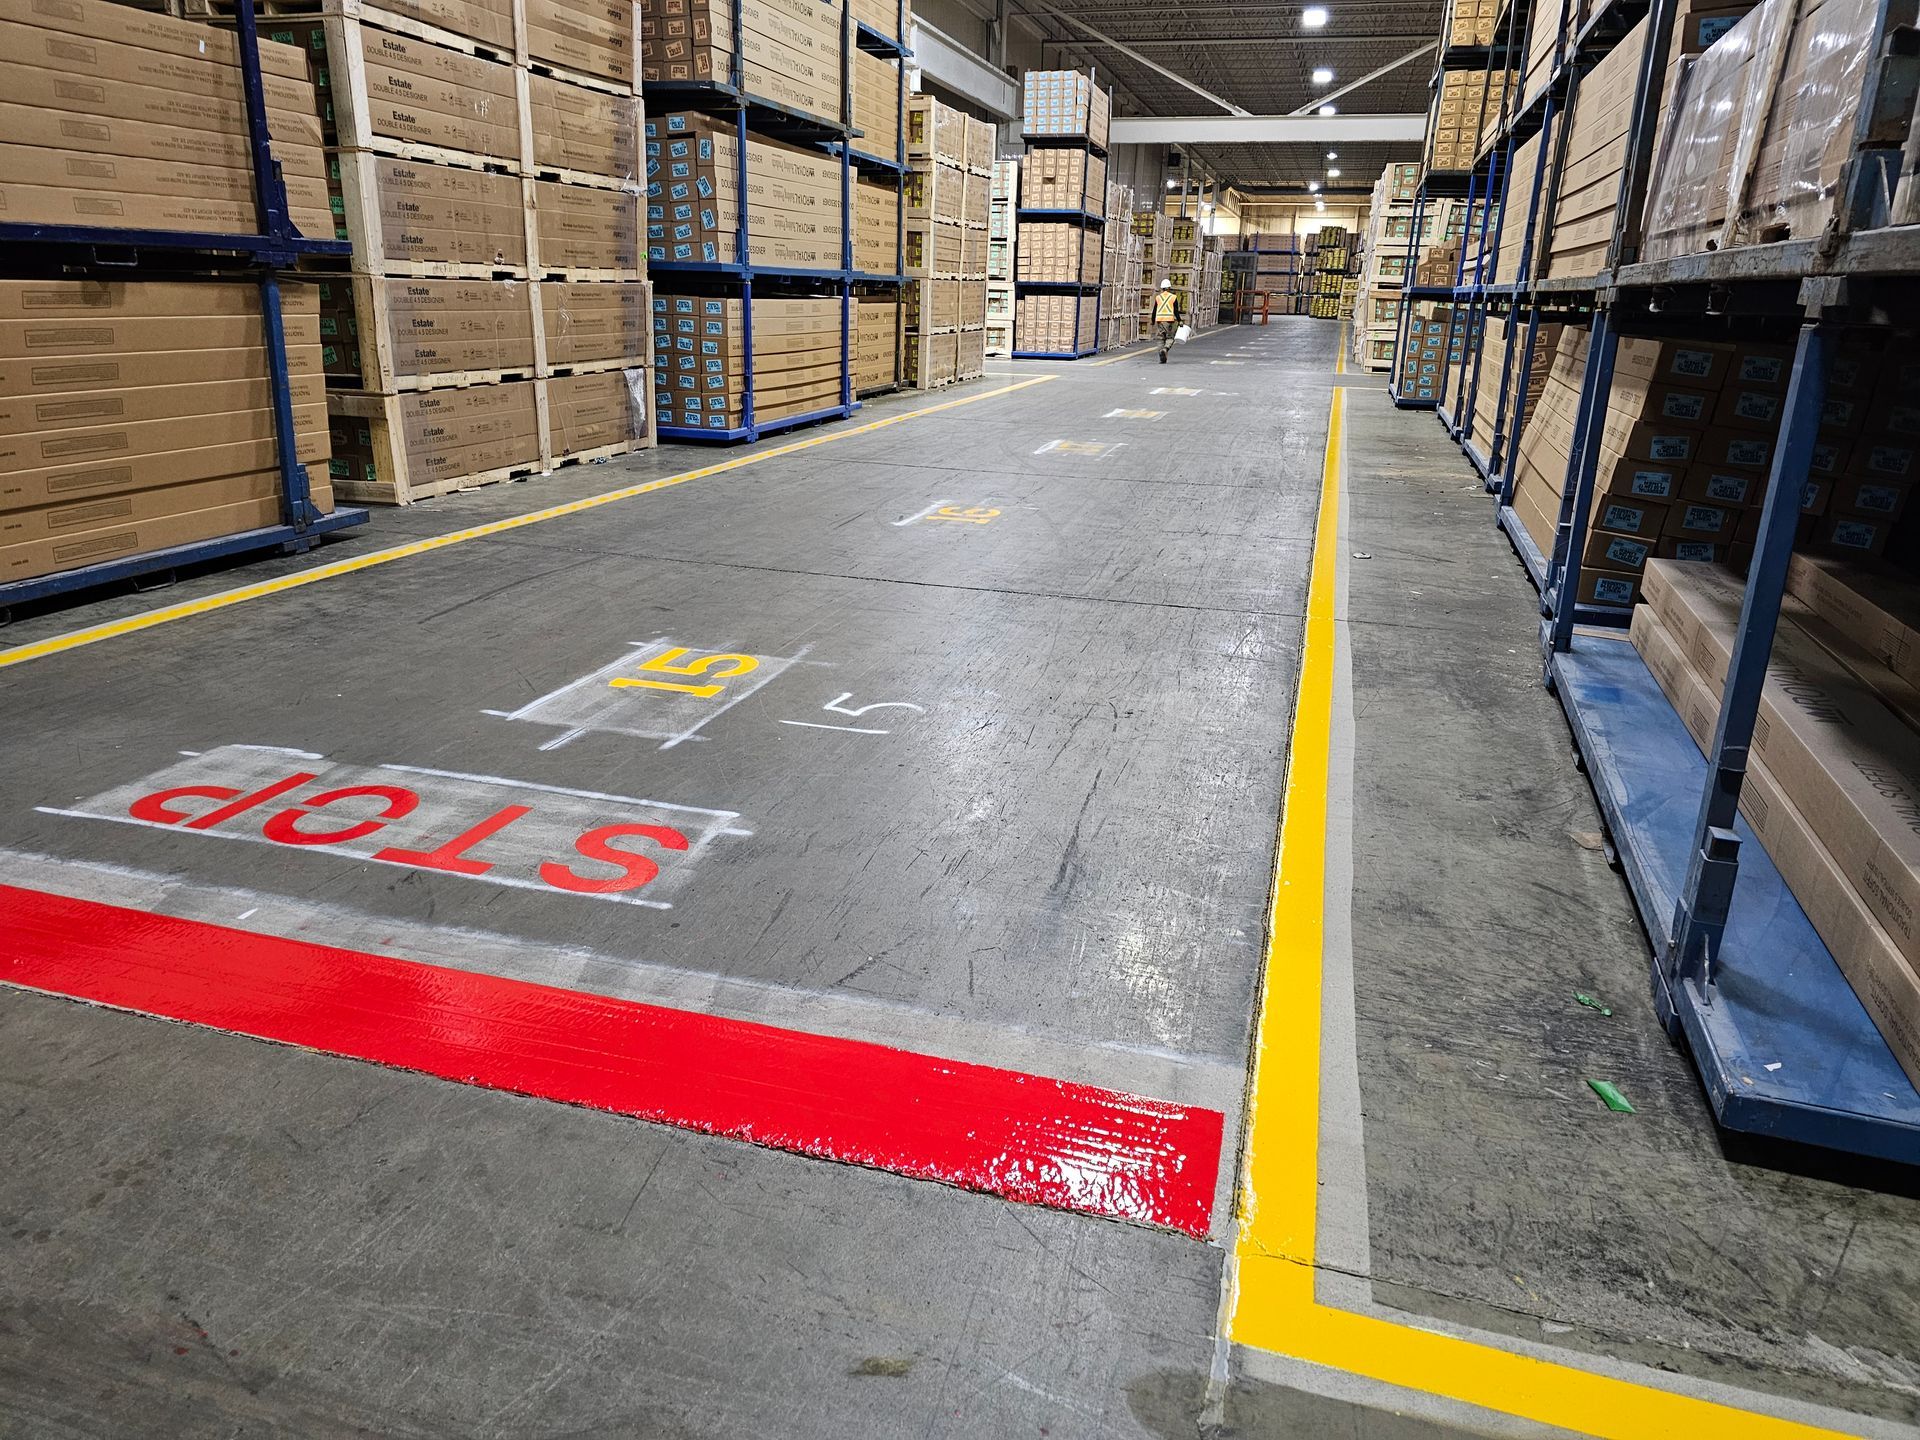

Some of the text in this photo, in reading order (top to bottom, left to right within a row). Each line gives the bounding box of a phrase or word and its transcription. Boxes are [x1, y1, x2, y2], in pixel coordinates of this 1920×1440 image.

[608, 8, 622, 20] Estate
[743, 4, 759, 20] ESIGNER
[792, 30, 808, 46] ROYAL
[382, 38, 406, 53] Estate
[366, 46, 390, 58] DOUBLE
[396, 52, 422, 66] DESIGNER
[608, 64, 622, 74] Estate
[793, 61, 809, 77] ROYAL
[388, 76, 412, 90] Estate
[744, 72, 762, 84] ESIGNER
[372, 83, 395, 96] DOUBLE
[402, 90, 428, 102] DESIGNER
[793, 90, 809, 106] ROYAL
[392, 111, 416, 124] Estate
[378, 118, 399, 130] DOUBLE
[406, 124, 432, 136] DESIGNER
[720, 146, 737, 158] DOUBLE
[746, 153, 763, 164] ESIGNER
[393, 168, 416, 178] Estate
[793, 164, 810, 176] ROYAL
[747, 184, 764, 194] ESIGNER
[794, 193, 811, 205] ROYAL
[397, 202, 420, 212] Estate
[723, 211, 738, 221] DOUBL
[294, 220, 319, 228] TRADITION
[795, 222, 812, 234] ROYAL
[401, 234, 424, 244] Estate
[414, 245, 438, 254] DESIGNER
[724, 243, 736, 252] DOUB
[795, 250, 812, 260] ROYAL
[408, 286, 430, 296] Estate
[412, 319, 434, 328] Estate
[415, 349, 437, 358] Estate
[419, 399, 441, 408] Estate
[432, 406, 455, 414] DESIGNER
[424, 427, 445, 436] Estate
[608, 646, 761, 699] 15
[778, 692, 928, 735] 15
[1851, 760, 1912, 802] SOFFIT
[129, 772, 690, 894] STOP
[1880, 890, 1912, 940] TRADITIONAL
